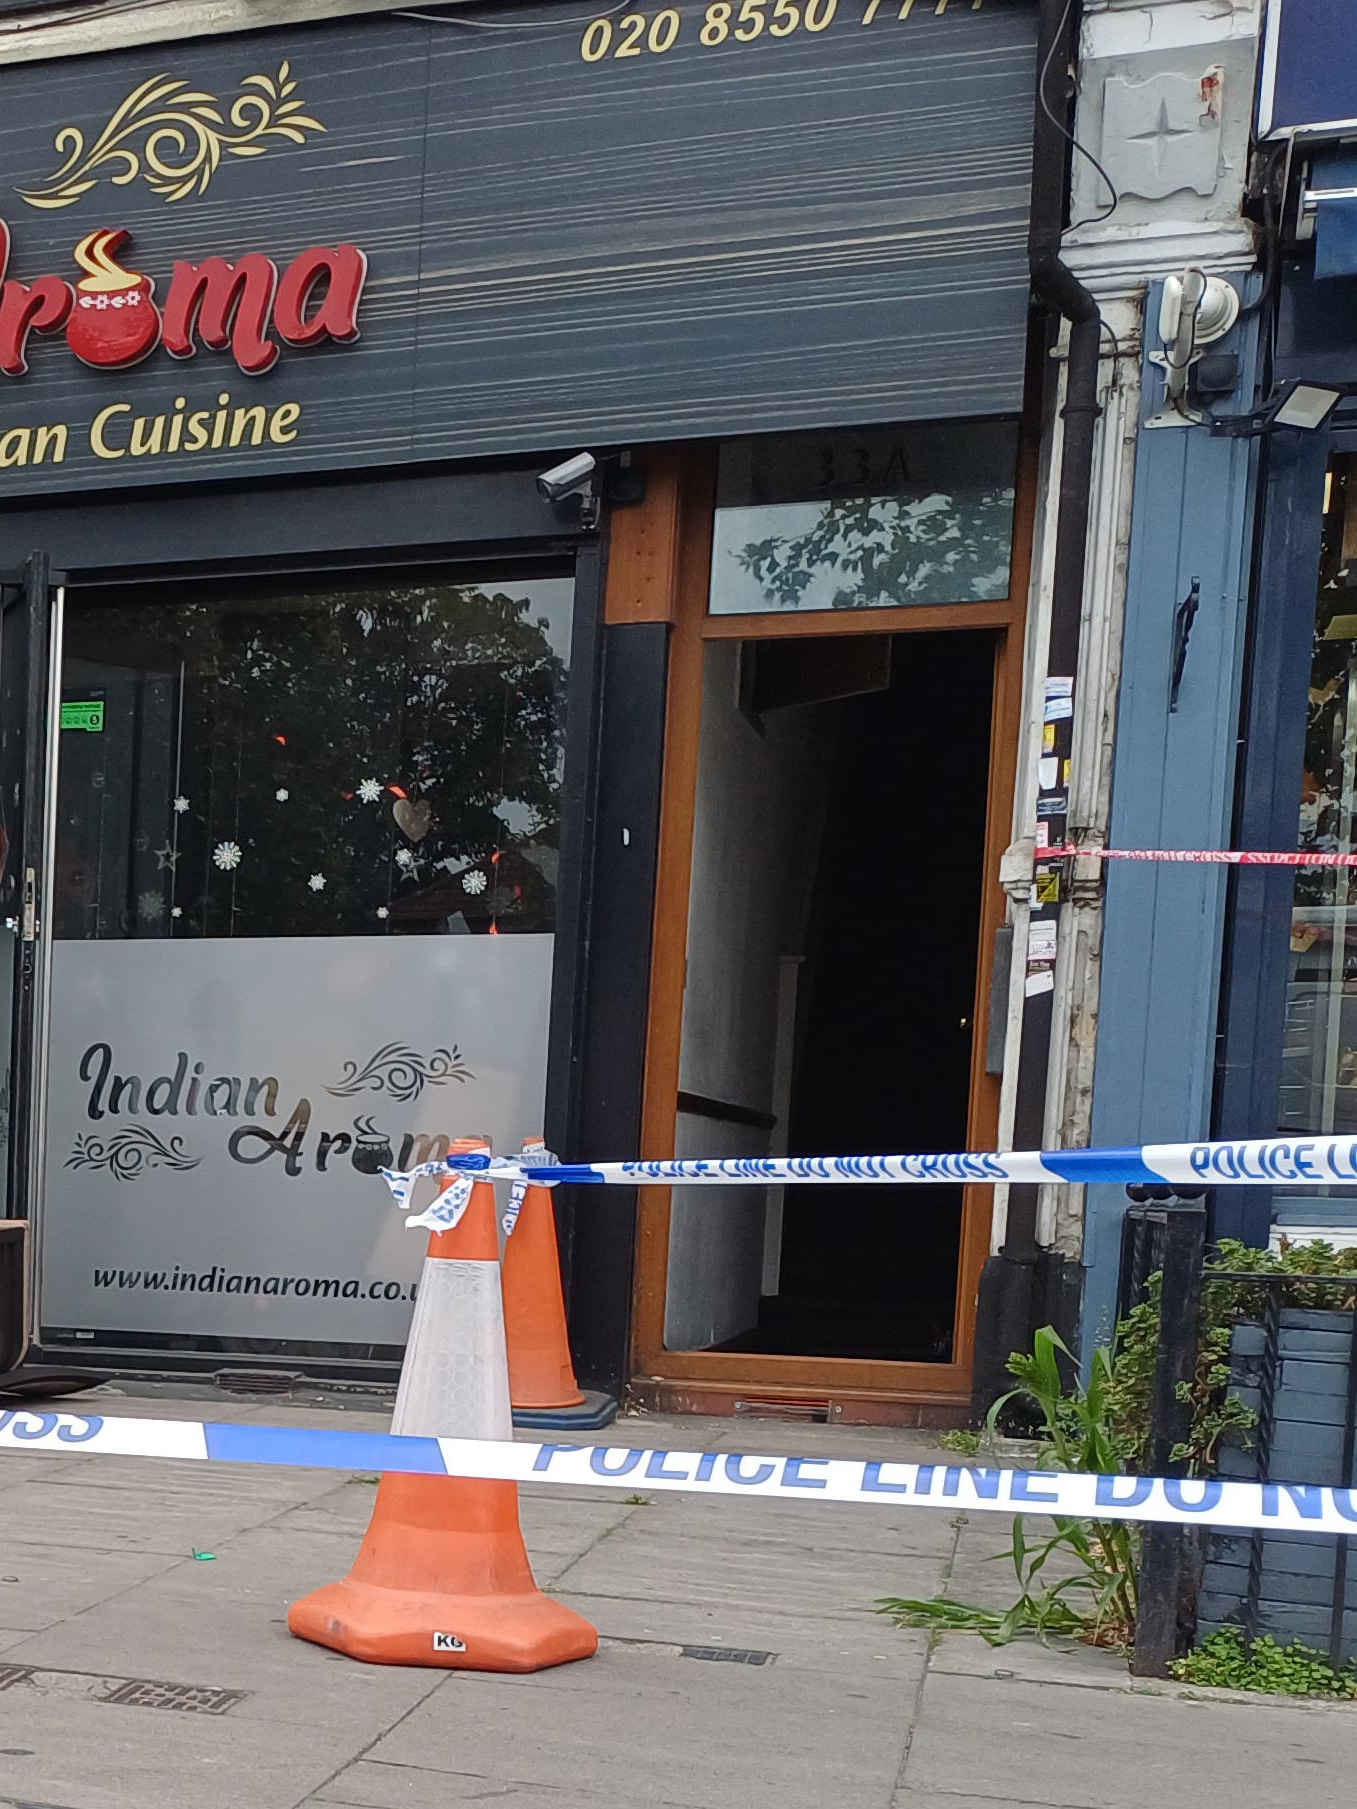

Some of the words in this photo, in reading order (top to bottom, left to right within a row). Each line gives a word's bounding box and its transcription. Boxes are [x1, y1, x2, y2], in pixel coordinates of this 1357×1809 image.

[580, 9, 682, 63] 020
[699, 0, 838, 46] 8550
[90, 395, 301, 459] Cuisine
[79, 1042, 279, 1121] Indian
[900, 1153, 1010, 1178] CROSS
[1189, 1143, 1324, 1180] POLICE
